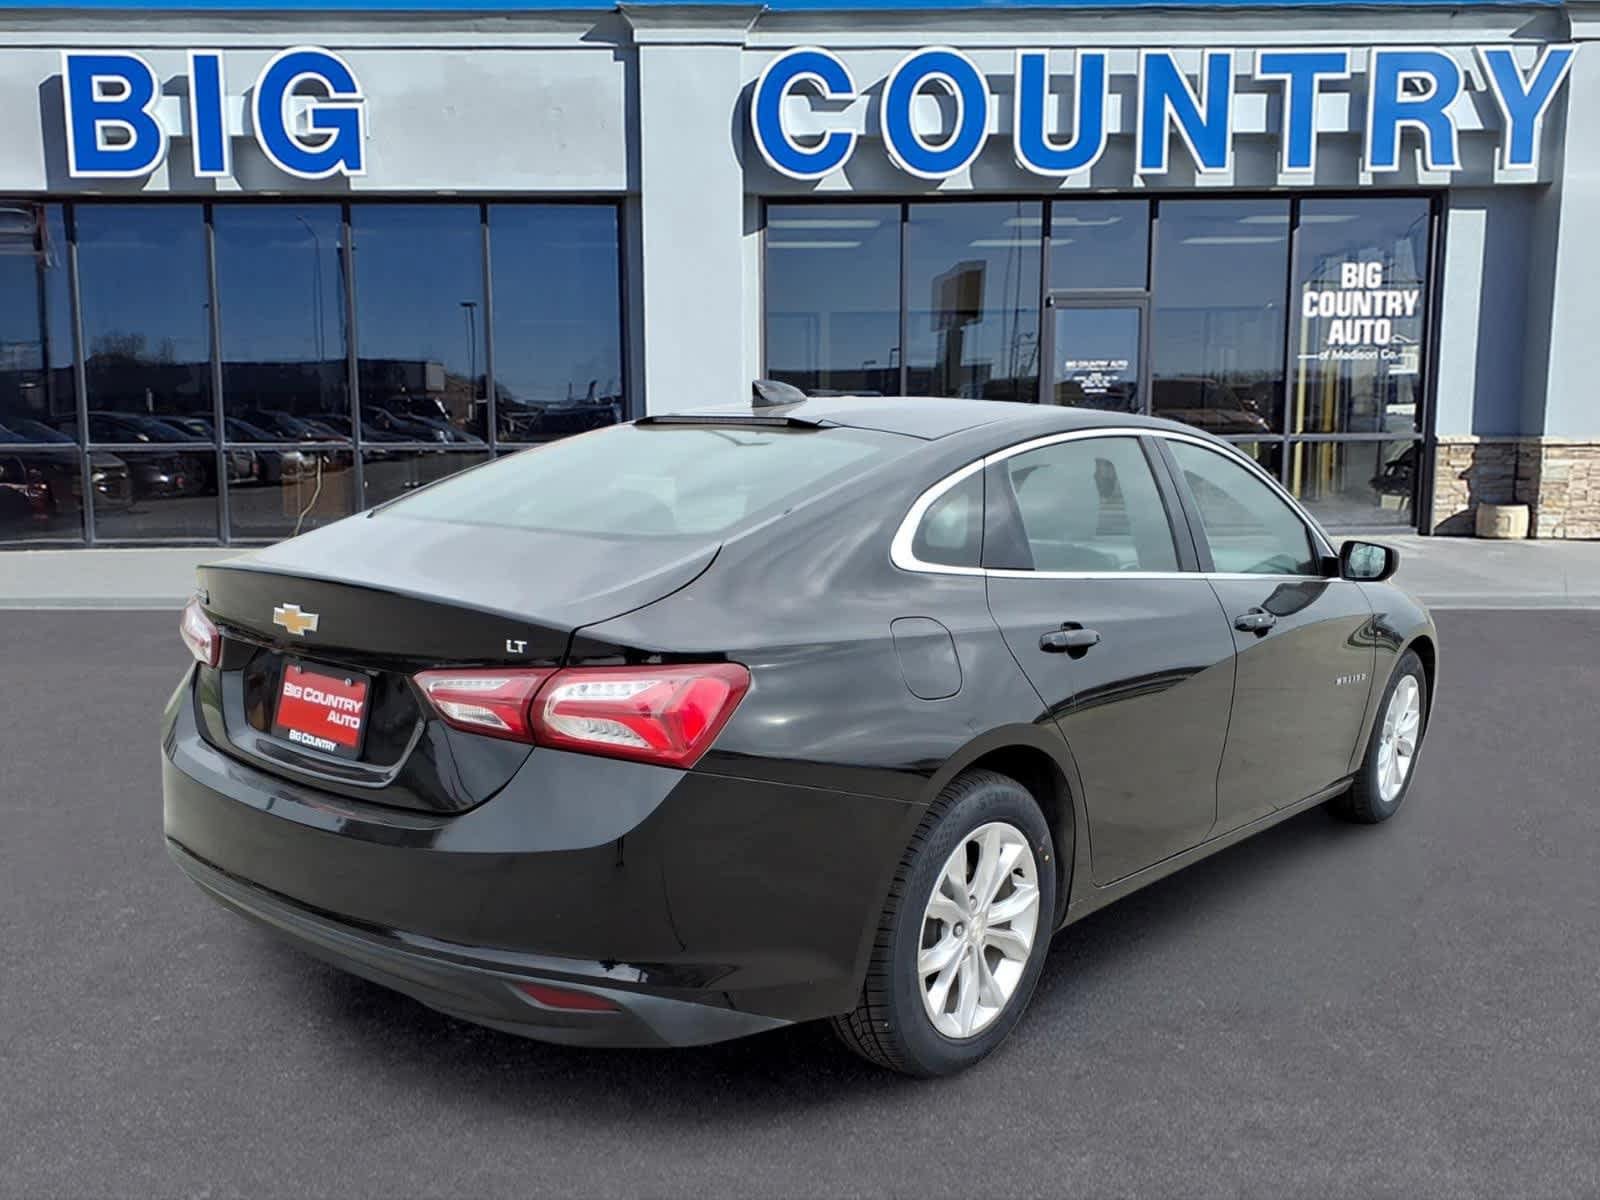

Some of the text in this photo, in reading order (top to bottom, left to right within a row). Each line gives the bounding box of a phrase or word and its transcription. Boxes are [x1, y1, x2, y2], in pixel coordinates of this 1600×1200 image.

[61, 45, 1576, 183] BIG COUNTRY
[1341, 262, 1382, 289] BIG
[1302, 290, 1419, 317] COUNTRY
[1328, 319, 1391, 345] AUTO
[506, 639, 527, 654] LT
[283, 682, 363, 713] BIG COUNTRY
[327, 710, 361, 729] AUTO
[289, 729, 336, 752] BIG COUNTRY
